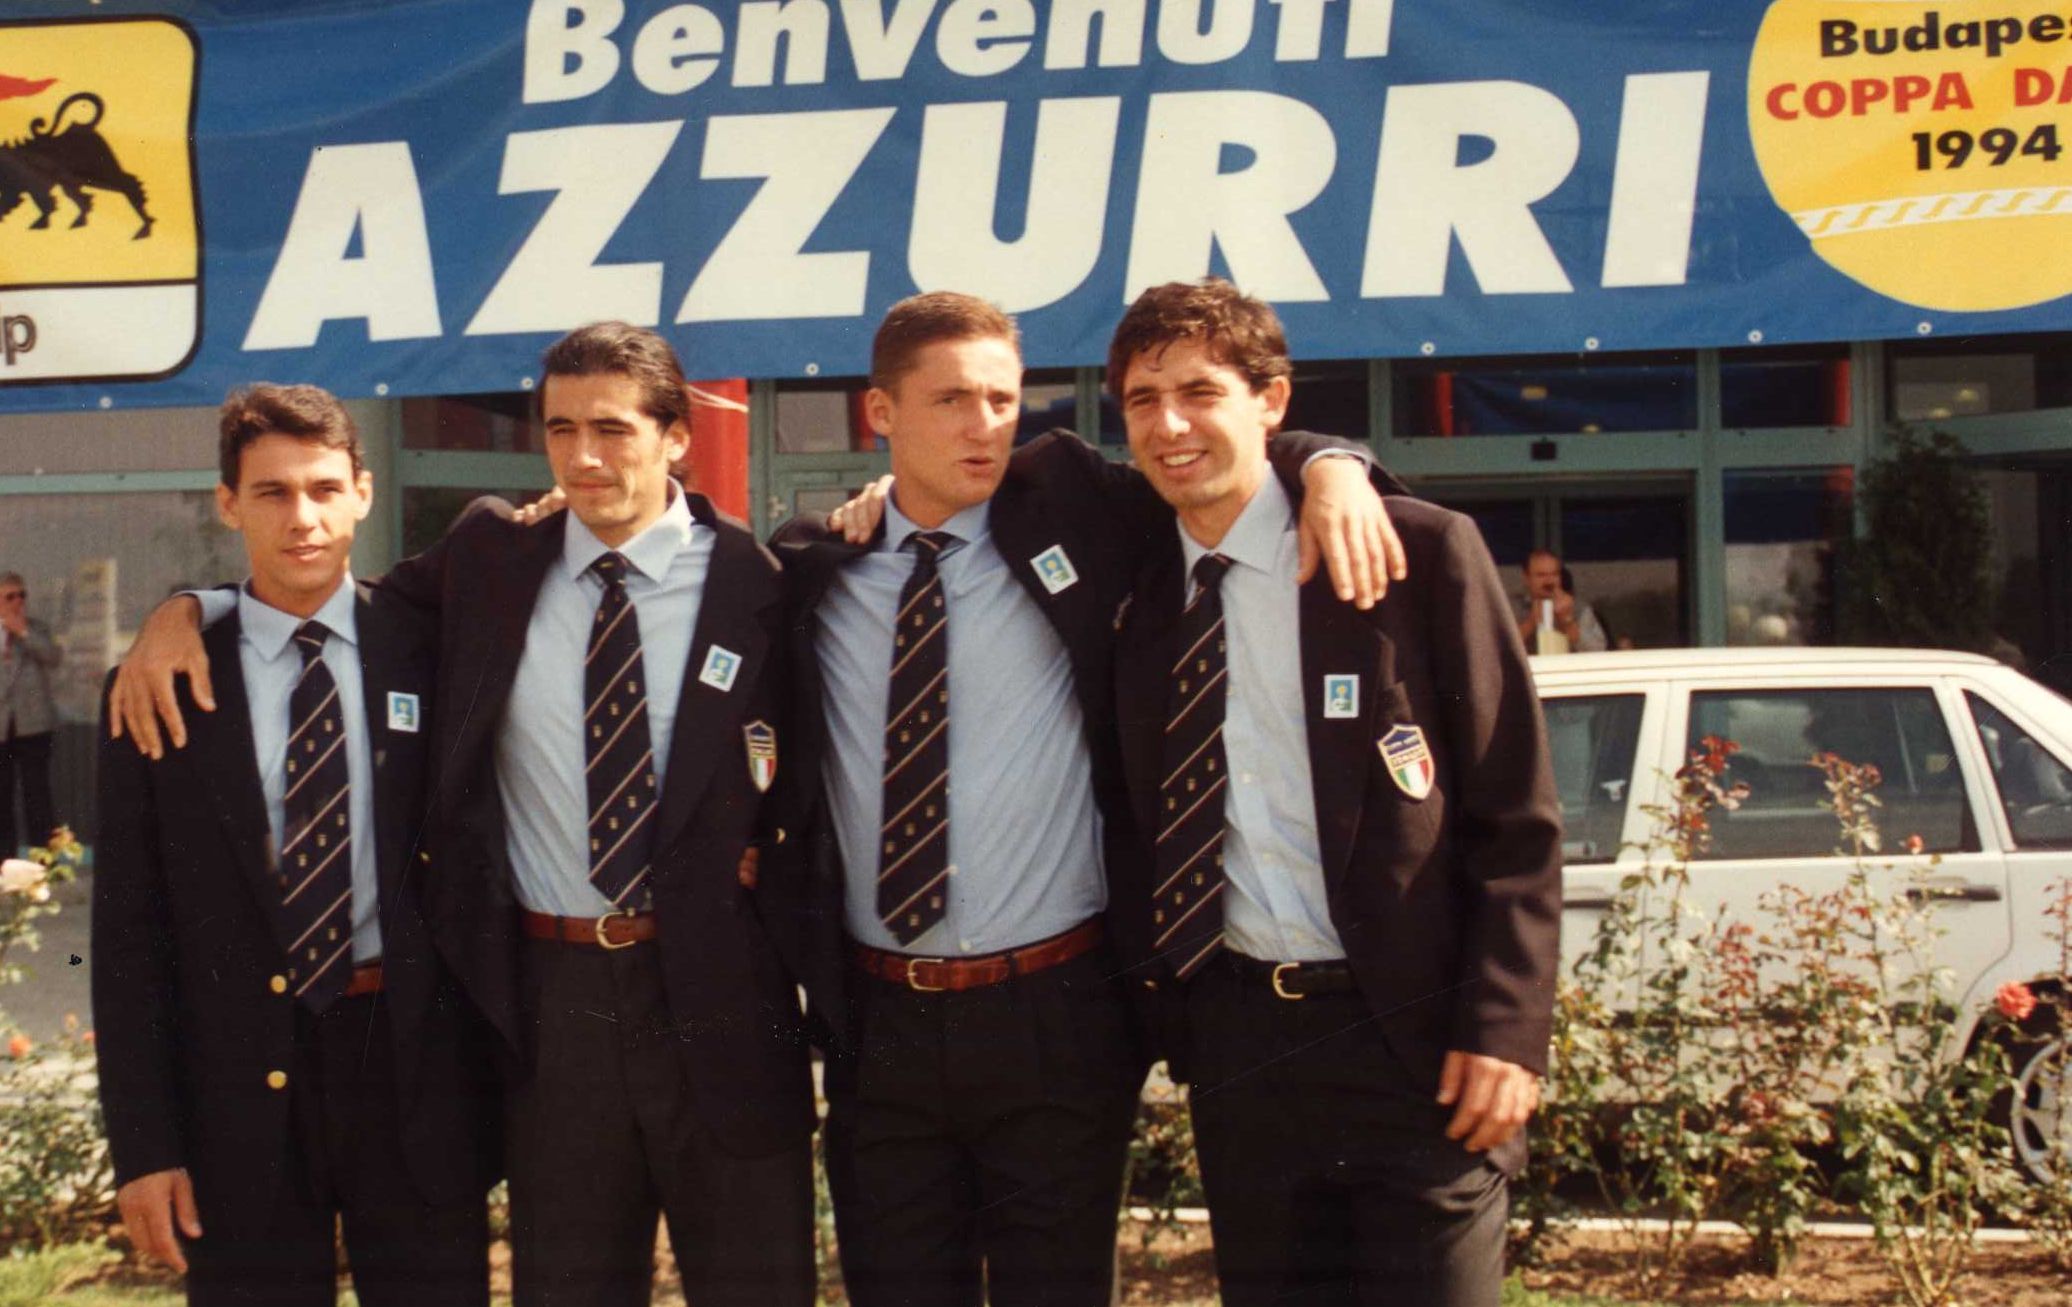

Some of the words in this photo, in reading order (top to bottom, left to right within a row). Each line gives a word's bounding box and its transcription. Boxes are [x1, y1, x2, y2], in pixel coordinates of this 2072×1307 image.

[1820, 11, 2072, 57] Budape
[1766, 72, 1974, 120] COPPA
[1912, 124, 2063, 171] 1994
[241, 70, 1710, 351] AZZURRI
